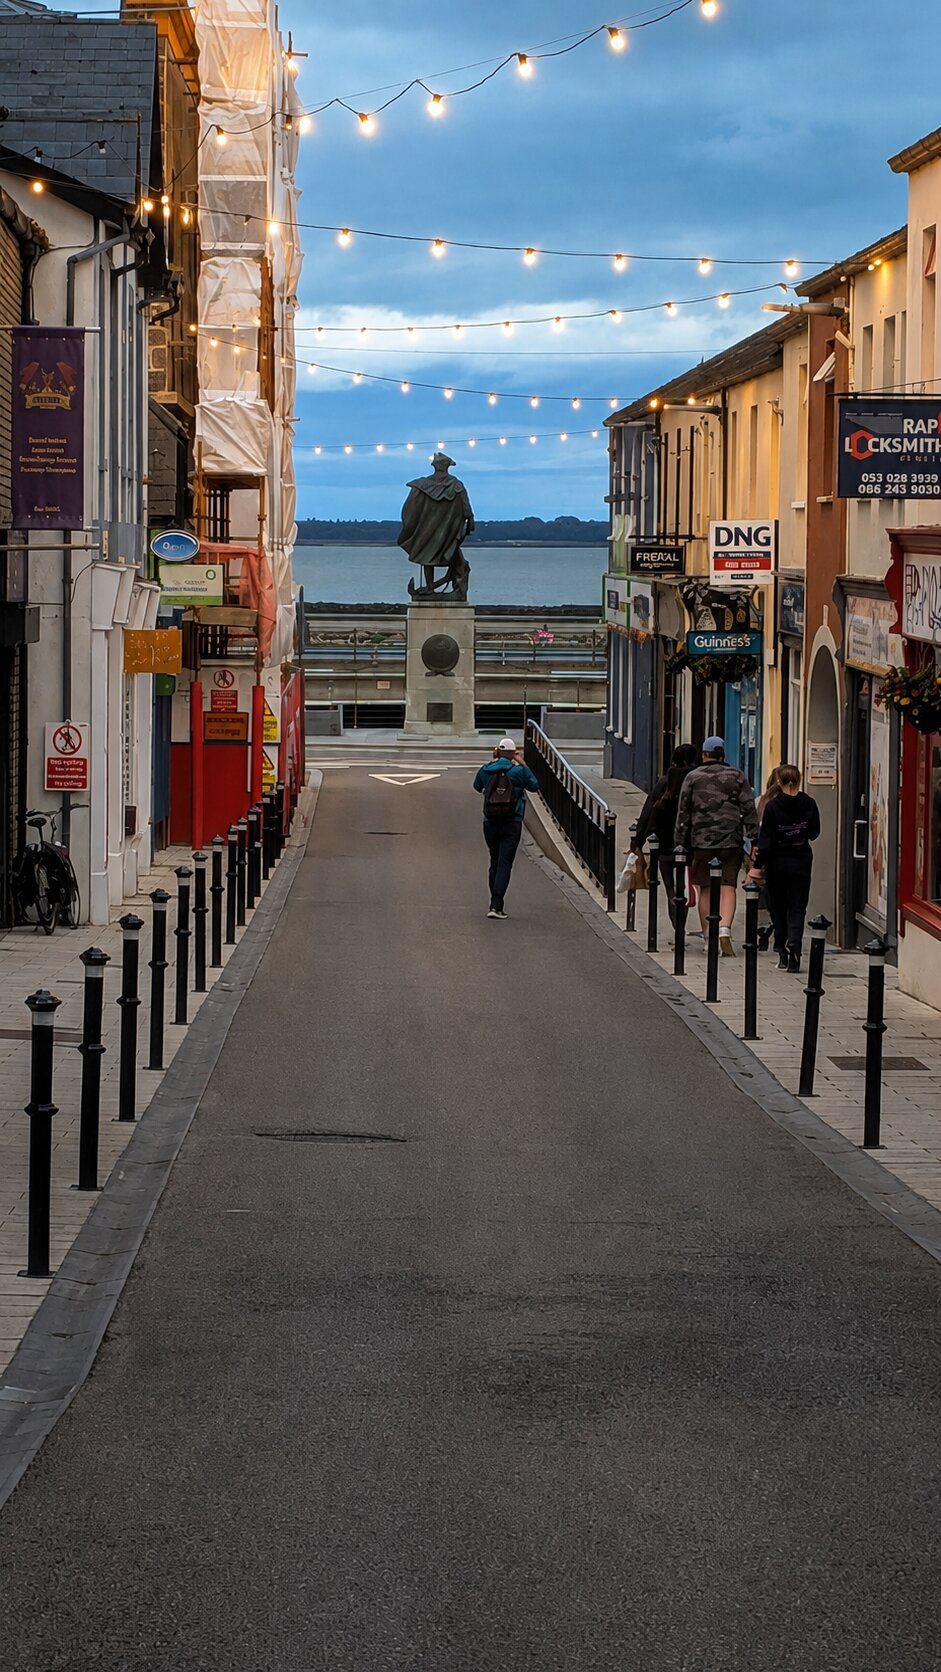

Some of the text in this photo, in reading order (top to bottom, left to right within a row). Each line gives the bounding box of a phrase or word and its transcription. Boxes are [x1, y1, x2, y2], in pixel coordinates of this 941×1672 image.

[861, 473, 939, 483] 053 028 3939
[858, 484, 940, 495] 086 243 9030
[715, 526, 771, 547] DNG
